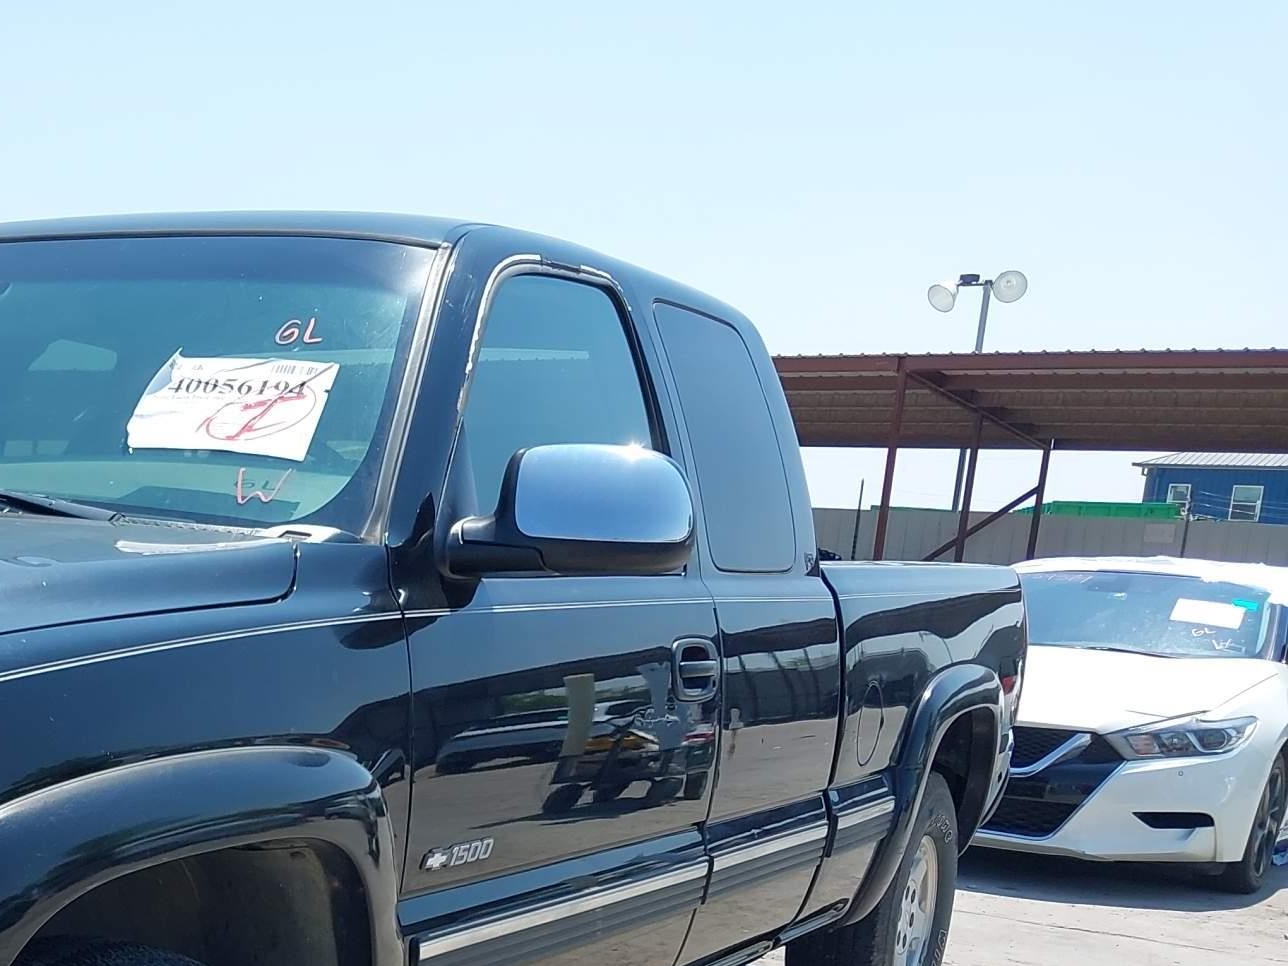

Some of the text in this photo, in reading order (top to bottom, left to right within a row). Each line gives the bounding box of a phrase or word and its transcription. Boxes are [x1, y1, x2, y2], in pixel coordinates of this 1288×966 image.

[275, 317, 323, 345] GL
[168, 377, 306, 396] 40056194
[450, 837, 494, 866] 1500
